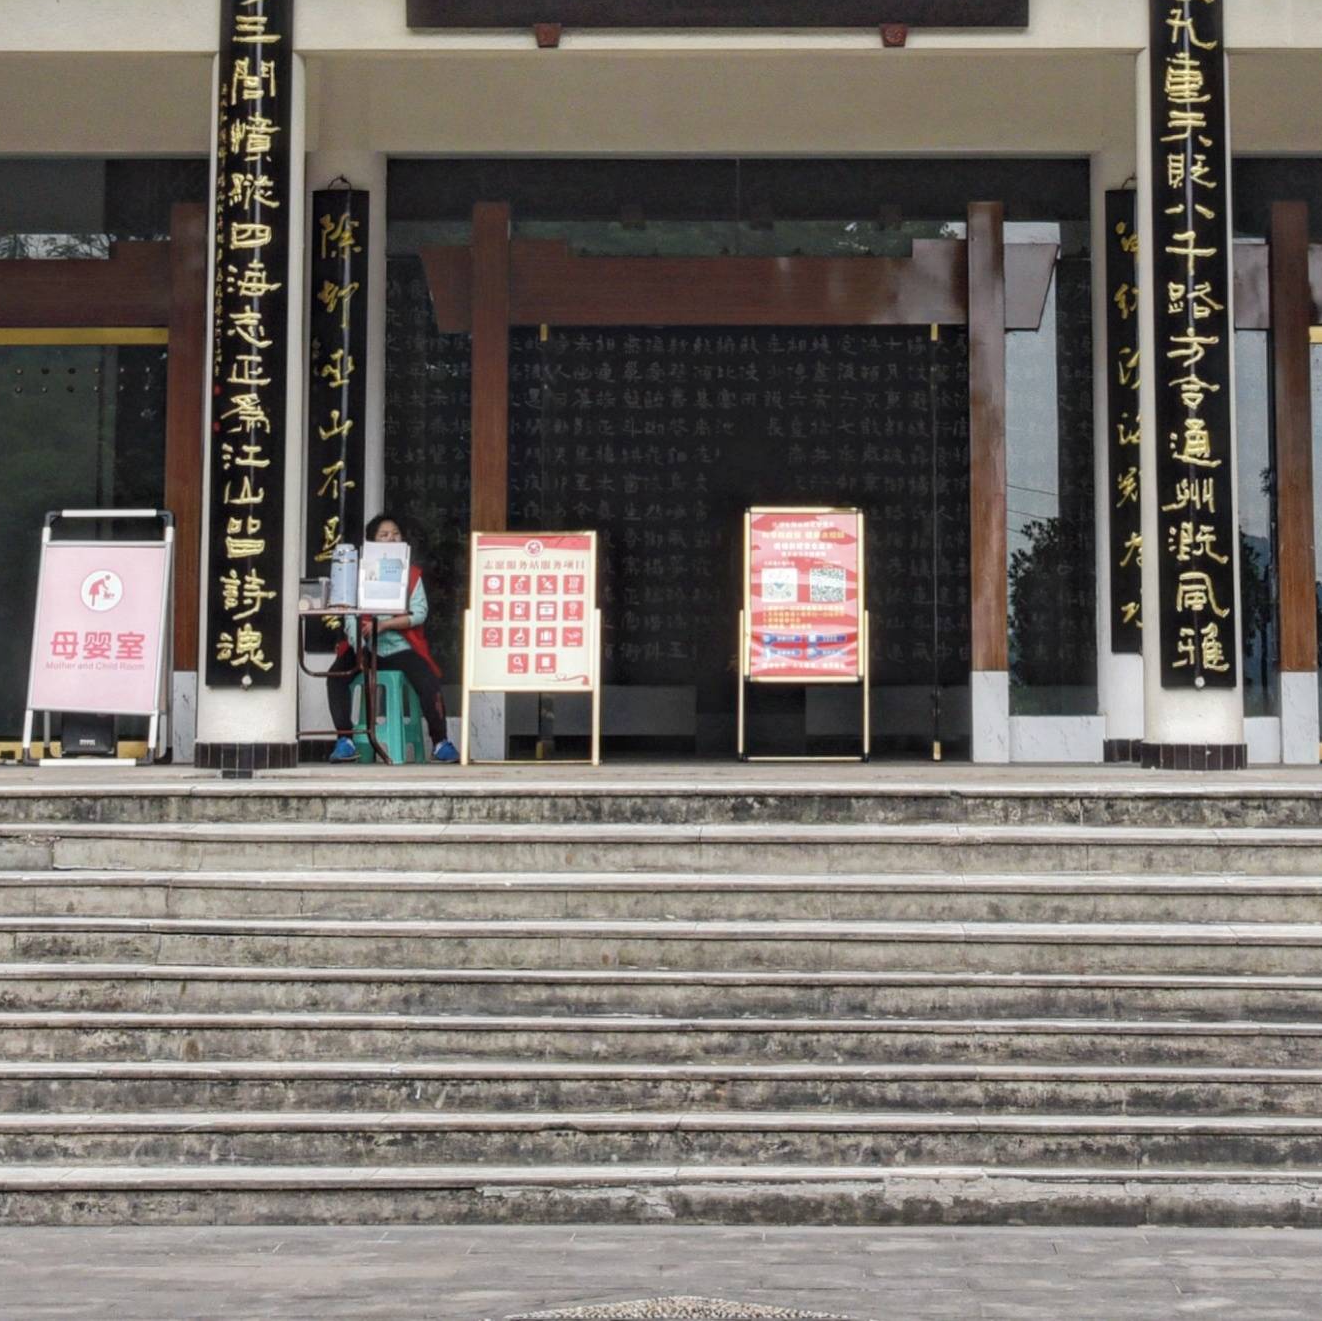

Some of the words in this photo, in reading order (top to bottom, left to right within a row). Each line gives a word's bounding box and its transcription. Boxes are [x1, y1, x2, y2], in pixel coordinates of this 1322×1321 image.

[50, 631, 145, 660] 母婴室
[45, 661, 76, 671] Mother
[77, 661, 94, 671] and
[95, 661, 118, 671] Child
[119, 661, 145, 671] Room
